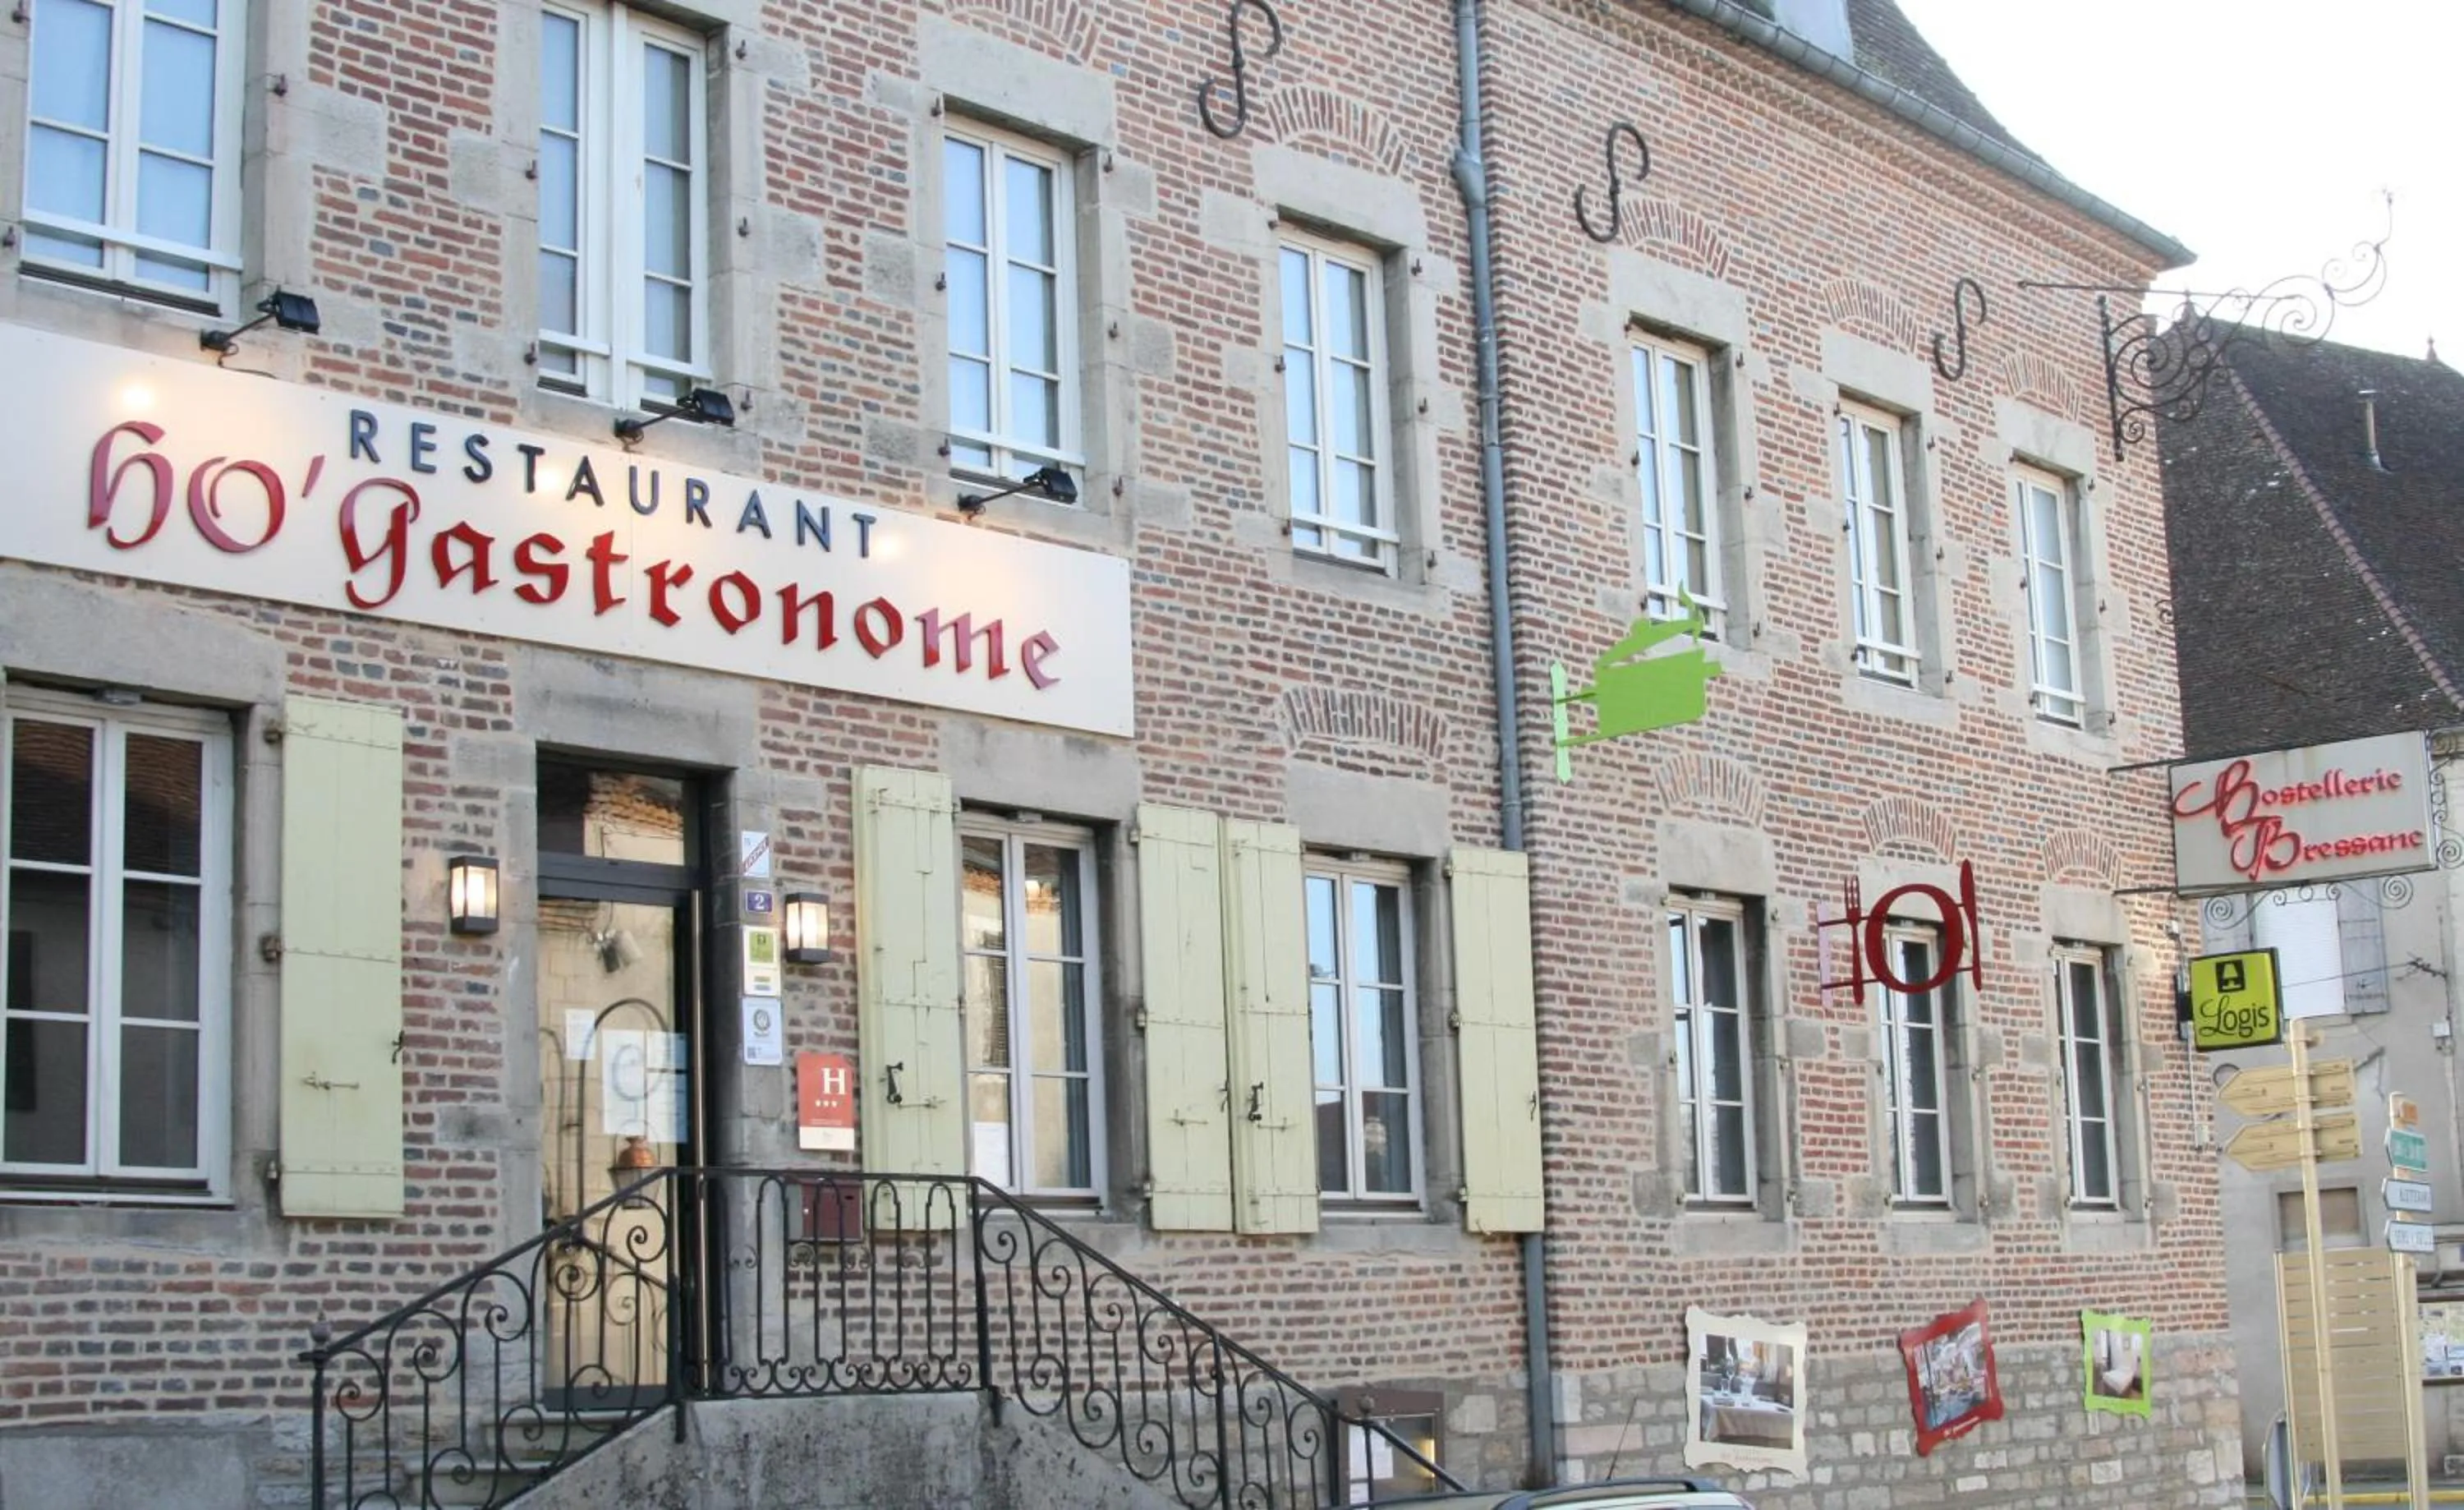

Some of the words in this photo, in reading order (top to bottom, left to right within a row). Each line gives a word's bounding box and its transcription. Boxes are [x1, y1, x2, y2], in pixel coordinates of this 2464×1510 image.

[349, 409, 877, 559] RESTAURANT
[2172, 759, 2402, 838] Hostellerie
[2230, 815, 2425, 882] Bressane
[754, 893, 765, 910] 2
[2199, 995, 2271, 1038] Logis
[821, 1067, 847, 1096] H
